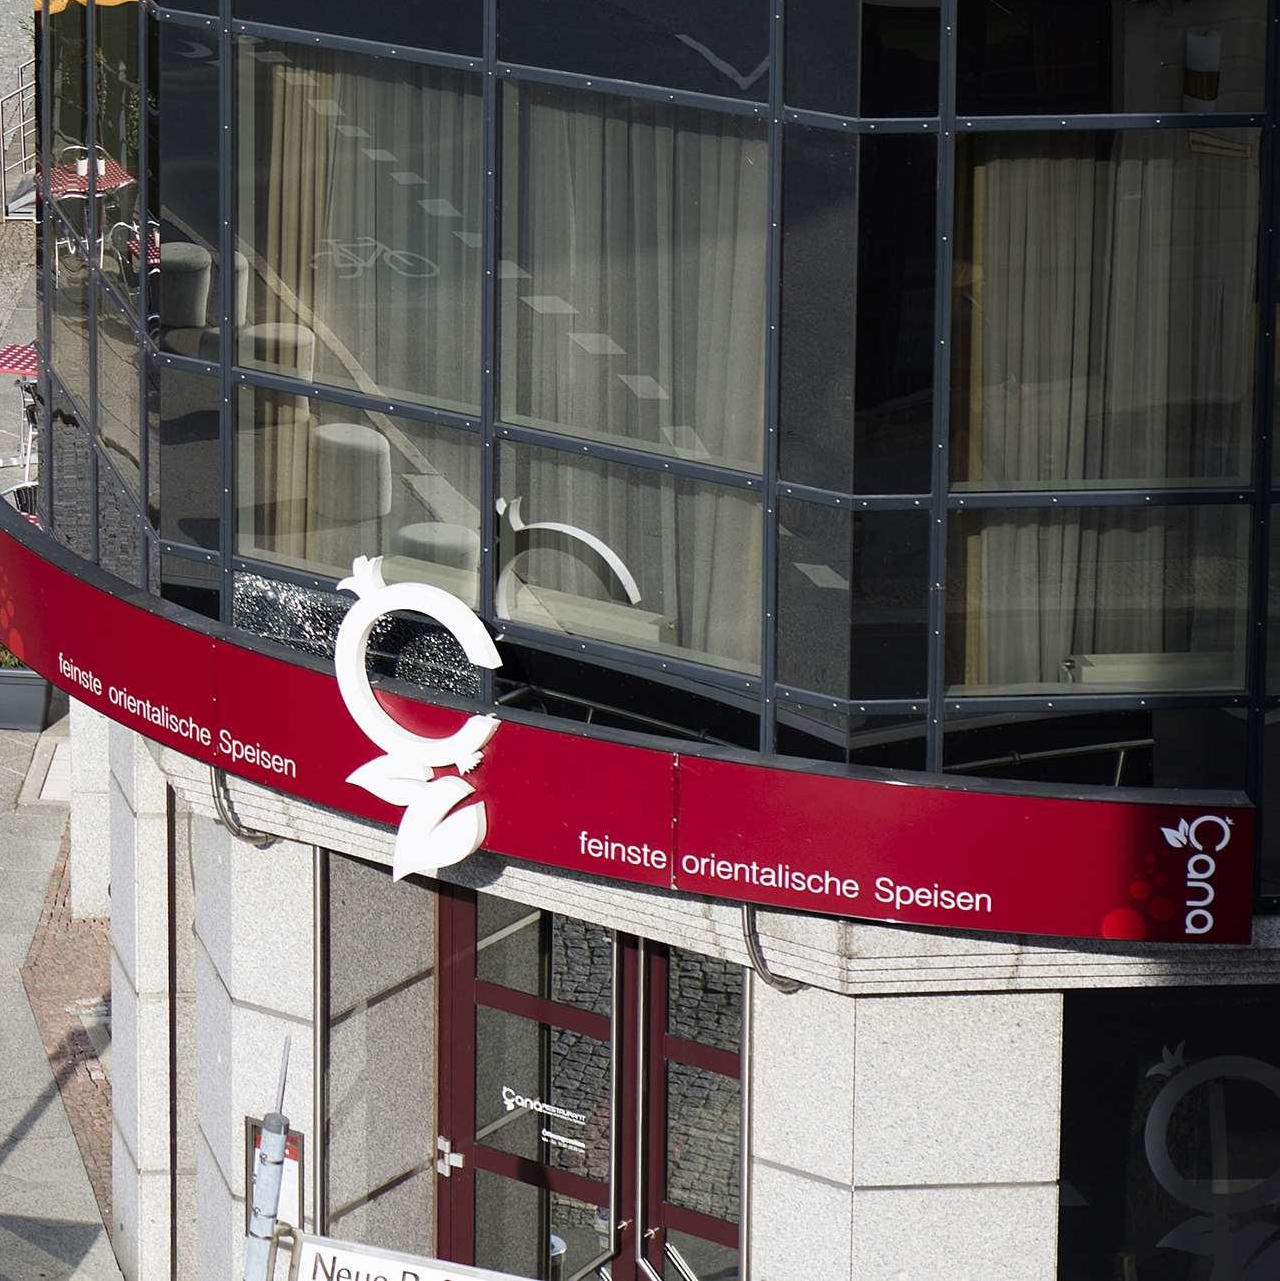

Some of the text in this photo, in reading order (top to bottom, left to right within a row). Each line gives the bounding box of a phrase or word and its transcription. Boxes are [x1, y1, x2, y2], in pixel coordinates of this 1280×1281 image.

[58, 652, 297, 778] feinste orientalische Speisen
[578, 830, 992, 912] feinste orientalische Speisen
